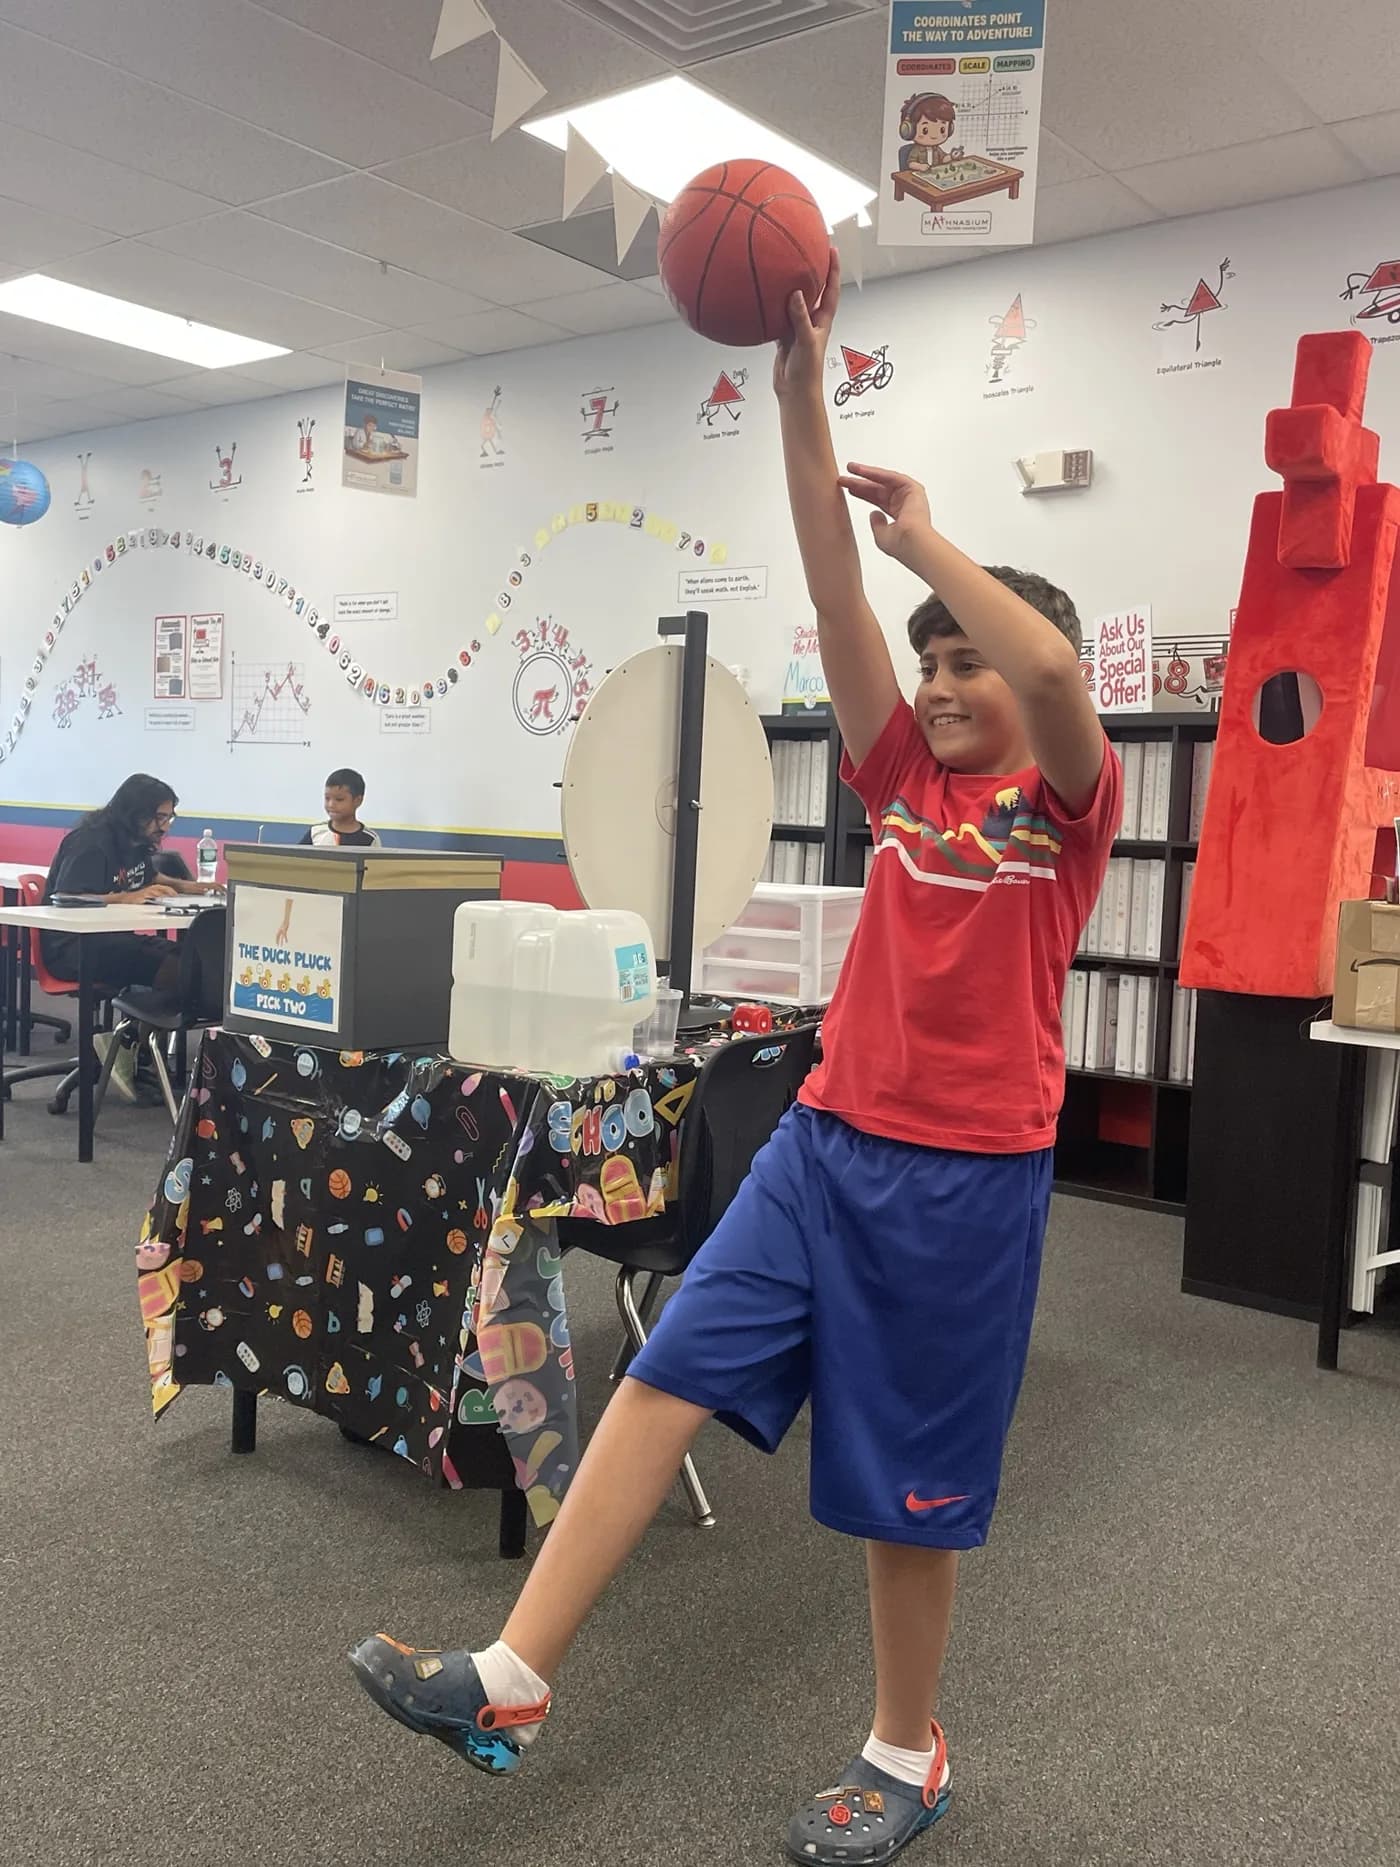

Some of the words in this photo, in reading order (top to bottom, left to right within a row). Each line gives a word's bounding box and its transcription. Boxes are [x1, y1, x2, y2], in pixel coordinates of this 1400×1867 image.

[914, 15, 986, 28] COORDINATES
[990, 12, 1023, 25] POINT
[902, 30, 922, 42] THE
[924, 30, 948, 42] WAY
[951, 30, 964, 41] TO
[967, 27, 1033, 41] ADVENTURE!
[962, 62, 986, 70] SCALE
[997, 59, 1031, 68] MAPPING
[1157, 362, 1192, 374] Equilateral
[1194, 358, 1222, 368] Triangle
[1100, 617, 1123, 643] Ask
[1127, 613, 1145, 637] Us
[1100, 642, 1125, 658] About
[1127, 637, 1144, 651] Our
[784, 661, 823, 693] Marco
[1100, 649, 1145, 684] Special
[1100, 675, 1146, 708] Offer!
[239, 943, 260, 962] THE
[262, 946, 291, 965] DUCK
[294, 951, 332, 971] PLUCK
[256, 993, 281, 1011] PICK
[283, 998, 307, 1015] TWO
